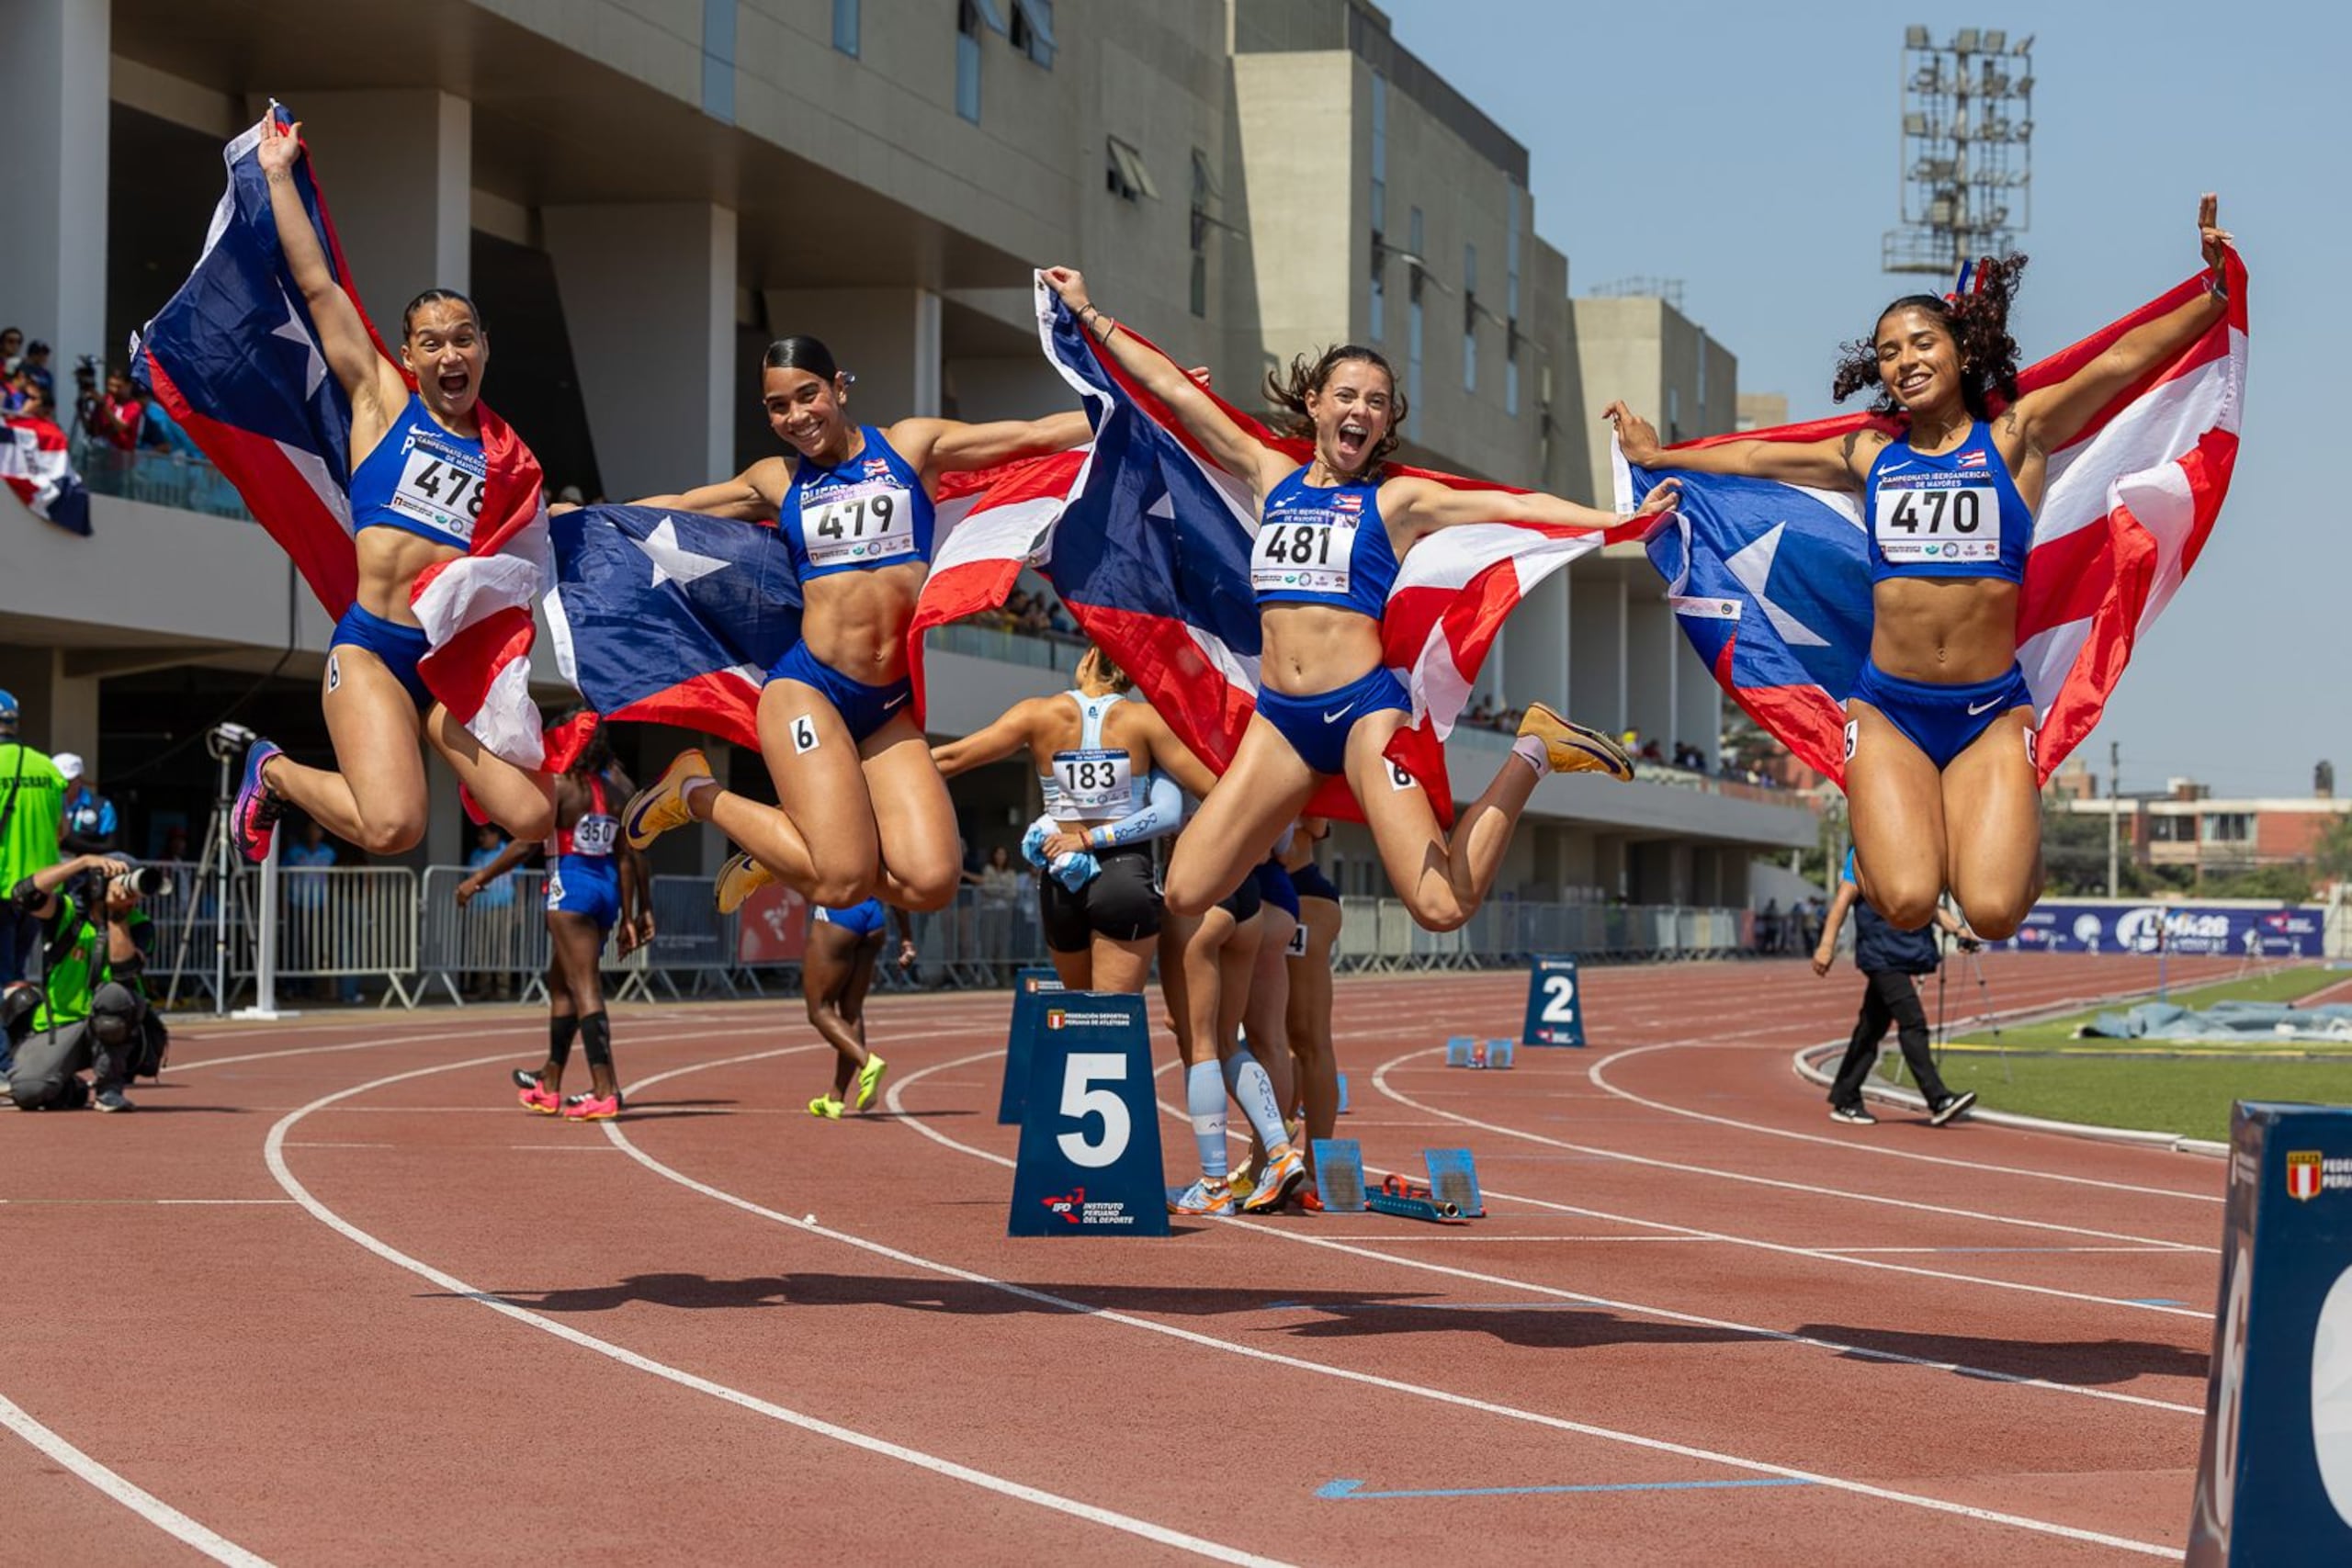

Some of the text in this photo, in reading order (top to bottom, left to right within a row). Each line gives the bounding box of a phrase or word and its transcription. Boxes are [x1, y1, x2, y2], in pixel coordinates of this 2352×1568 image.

[413, 459, 486, 519] 478
[1883, 473, 1930, 483] CAMPEONATO
[1928, 479, 1962, 488] MAYORES
[818, 494, 894, 539] 479
[1891, 491, 1979, 534] 470
[1265, 525, 1331, 564] 481
[331, 657, 339, 689] 6
[797, 719, 813, 750] 6
[1066, 761, 1116, 790] 183
[1393, 762, 1411, 785] 6
[581, 820, 611, 842] 350
[1288, 928, 1304, 953] 4
[1541, 976, 1574, 1023] 2
[1057, 1053, 1131, 1168] 5
[2323, 1158, 2352, 1173] FEDE
[1052, 1202, 1072, 1213] IPD
[1083, 1202, 1124, 1211] INSTITUTO
[1099, 1216, 1135, 1224] DEPORTE
